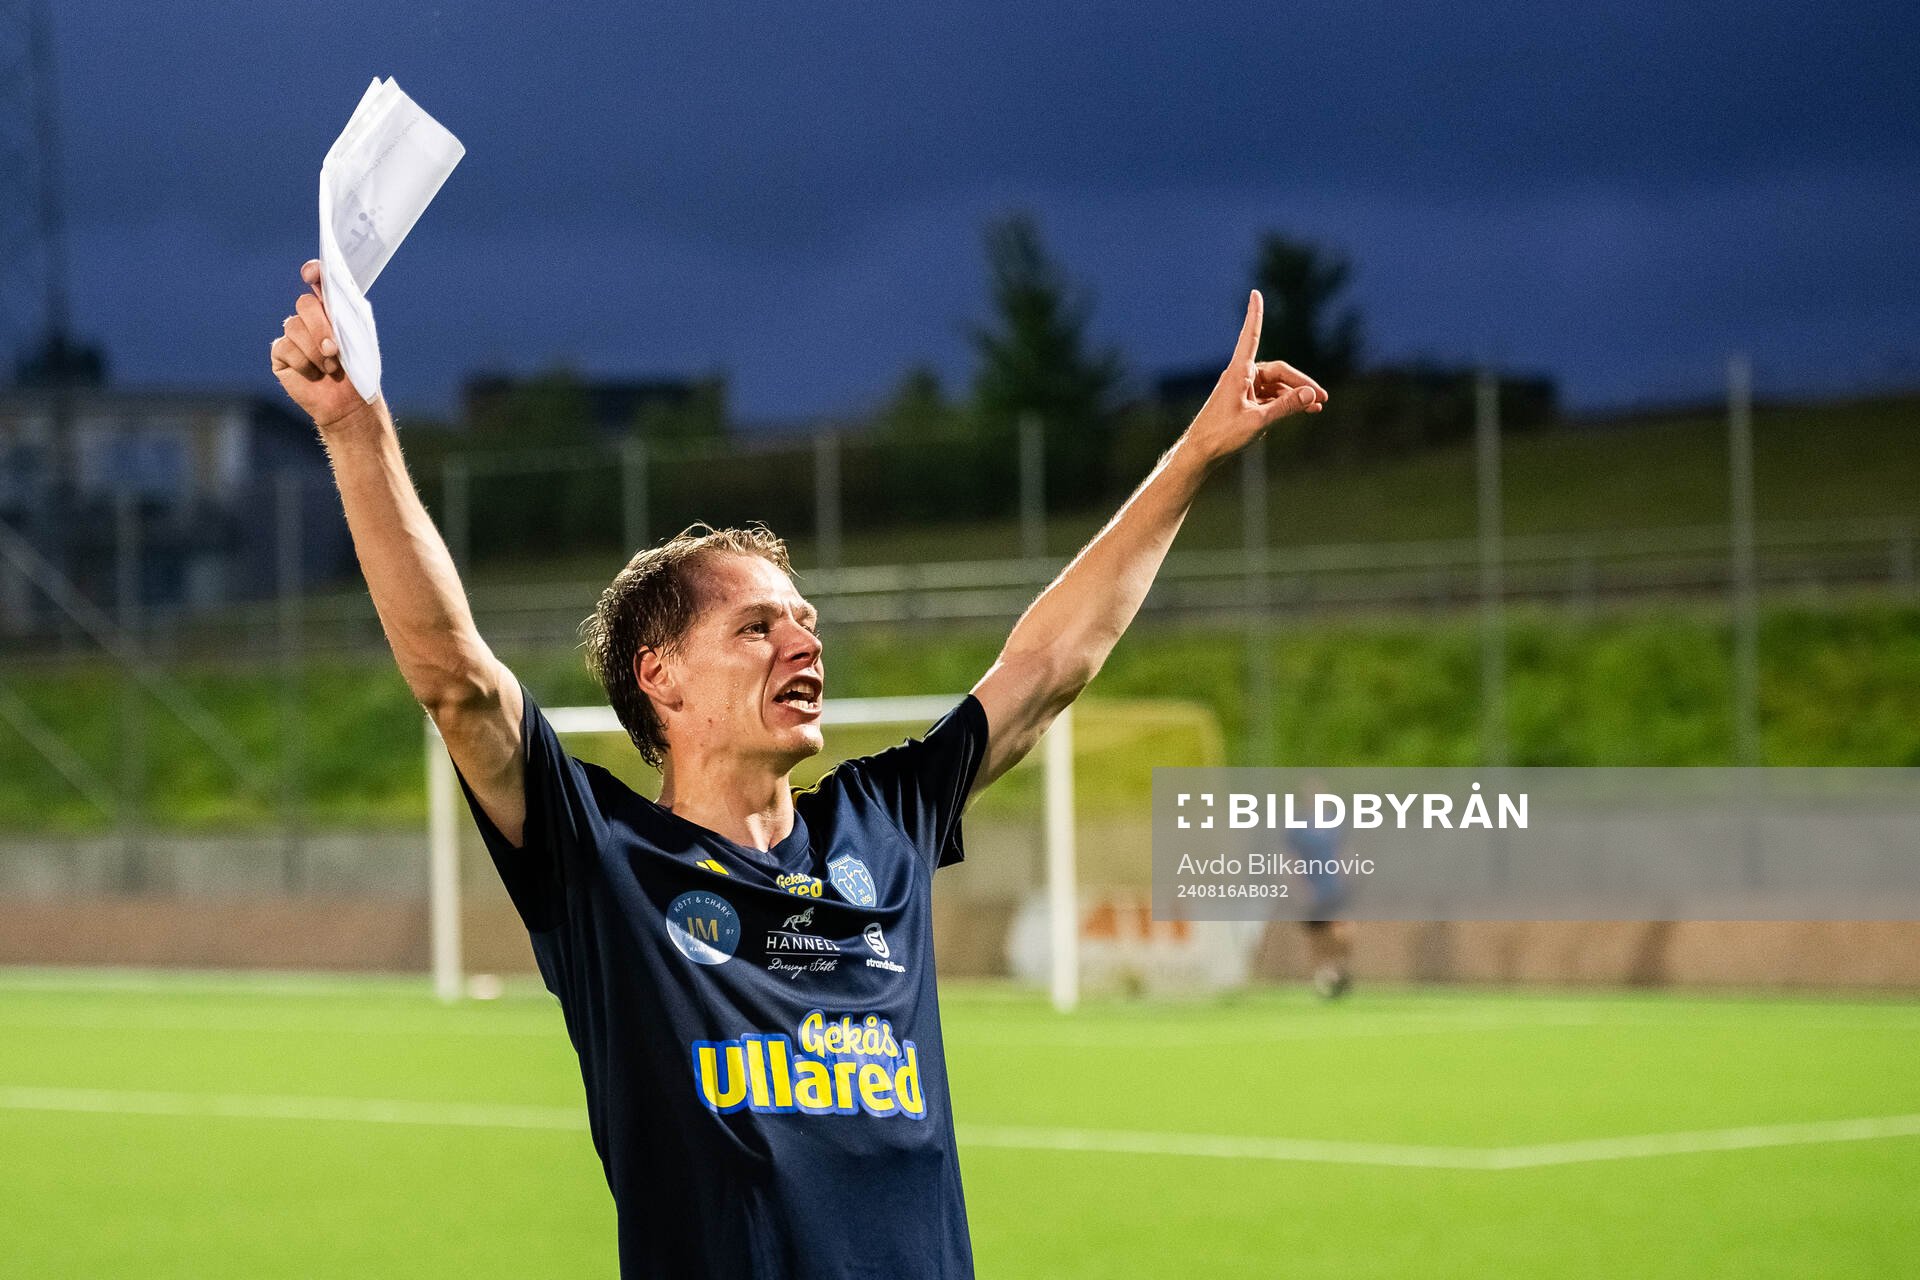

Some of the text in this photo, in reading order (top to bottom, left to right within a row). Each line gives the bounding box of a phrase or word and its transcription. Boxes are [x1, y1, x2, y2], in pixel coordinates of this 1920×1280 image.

[704, 897, 732, 918] CHARK
[801, 1013, 898, 1057] Gekås
[698, 1041, 924, 1114] Ullared
